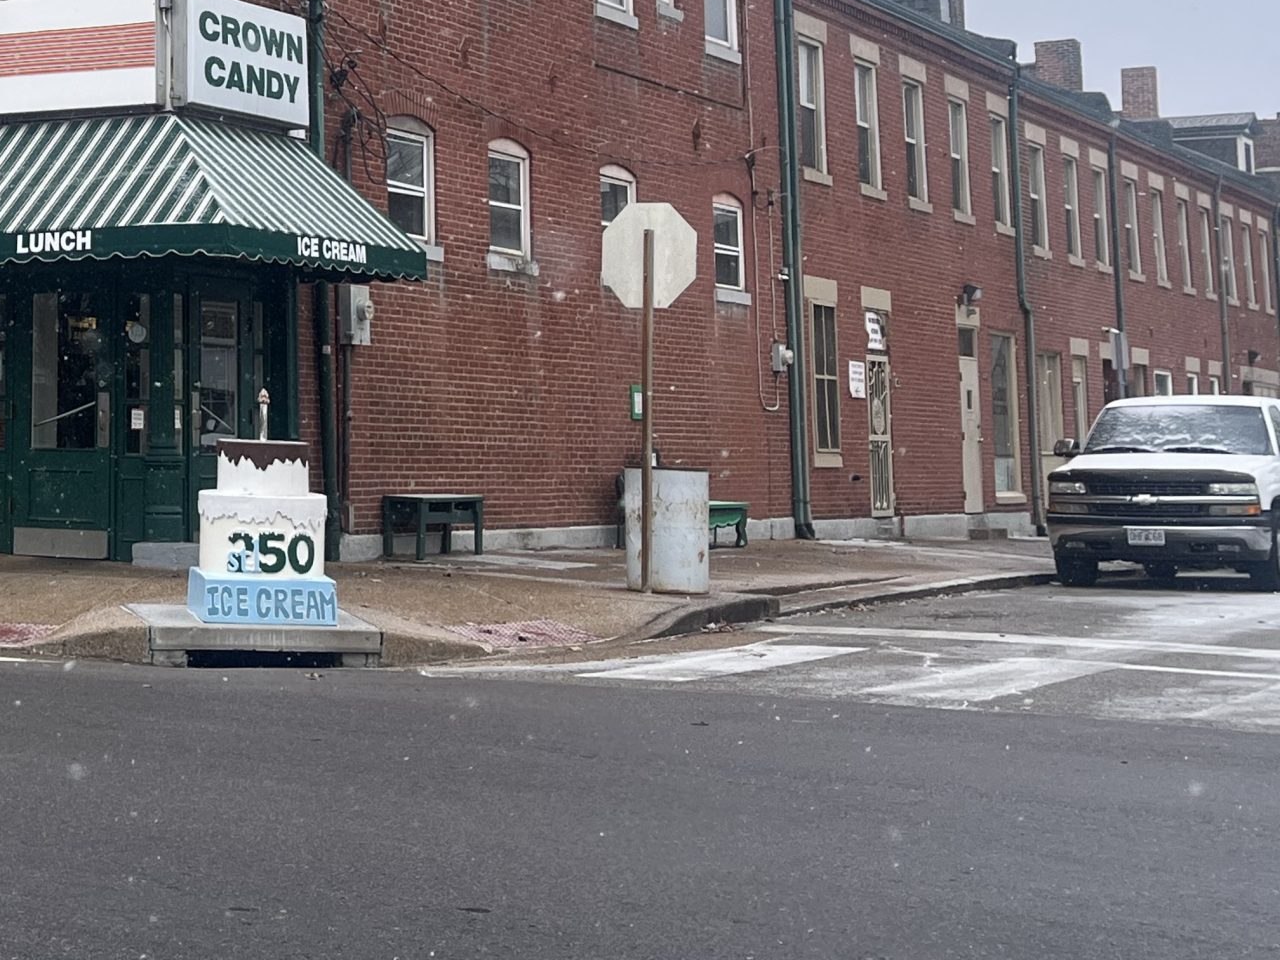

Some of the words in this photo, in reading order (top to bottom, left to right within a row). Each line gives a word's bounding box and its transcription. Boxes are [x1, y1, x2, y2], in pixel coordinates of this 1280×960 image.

[199, 10, 303, 65] CROWN
[204, 55, 300, 104] CANDY
[16, 230, 92, 254] LUNCH
[297, 236, 320, 258] ICE
[322, 239, 367, 264] CREAM
[206, 585, 250, 618] ICE
[256, 587, 337, 621] CREAM
